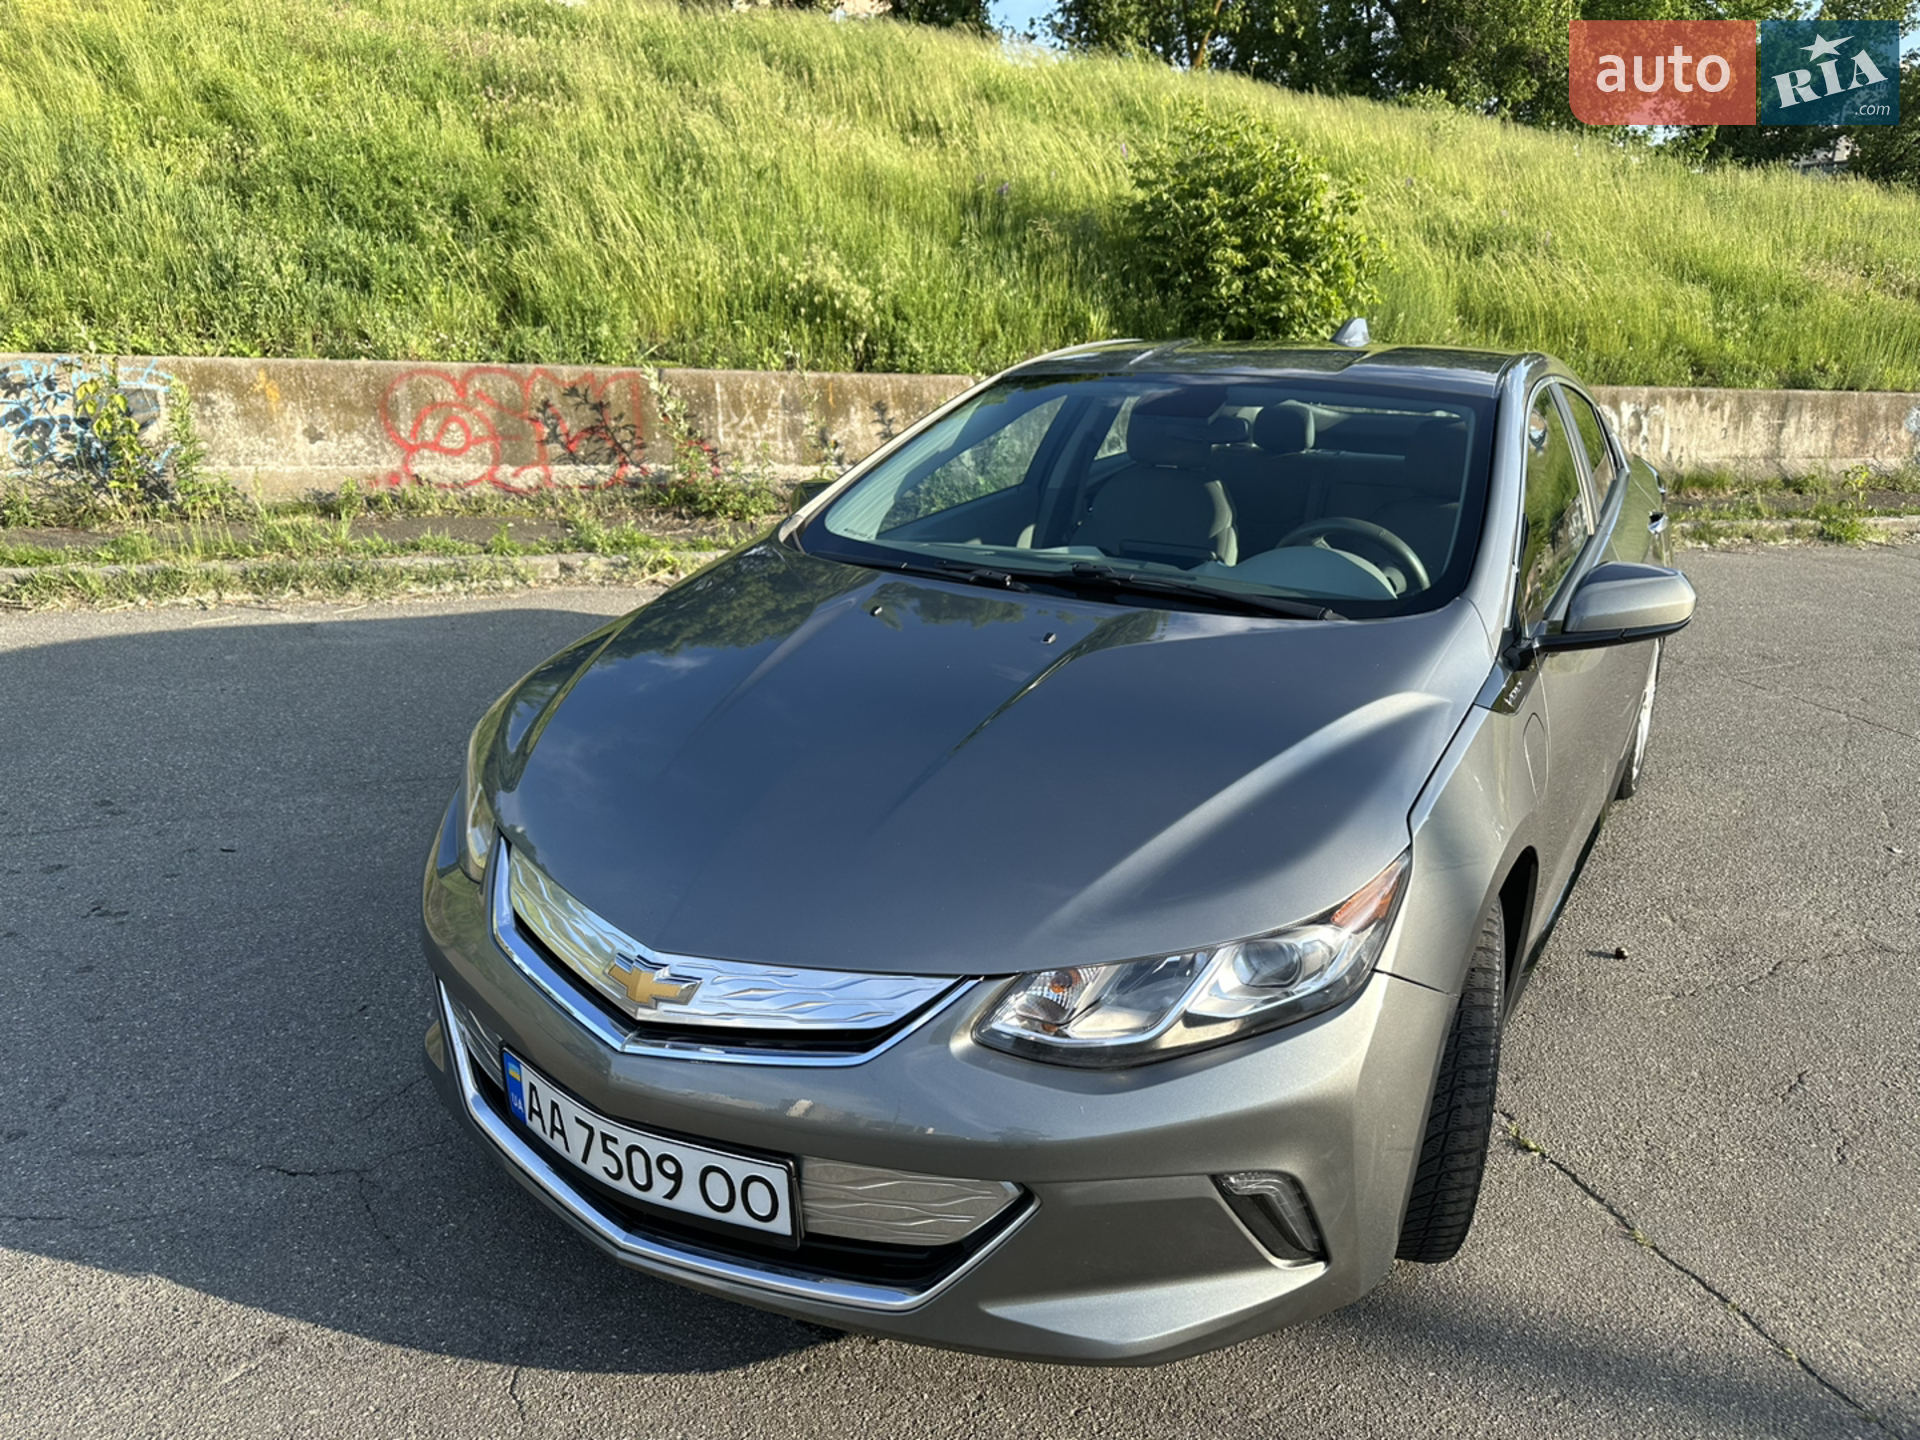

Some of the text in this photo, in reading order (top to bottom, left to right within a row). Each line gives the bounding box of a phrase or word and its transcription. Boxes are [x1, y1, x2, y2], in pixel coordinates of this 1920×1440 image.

[511, 1092, 525, 1114] UA
[528, 1081, 571, 1154] AA
[574, 1115, 684, 1201] 7509
